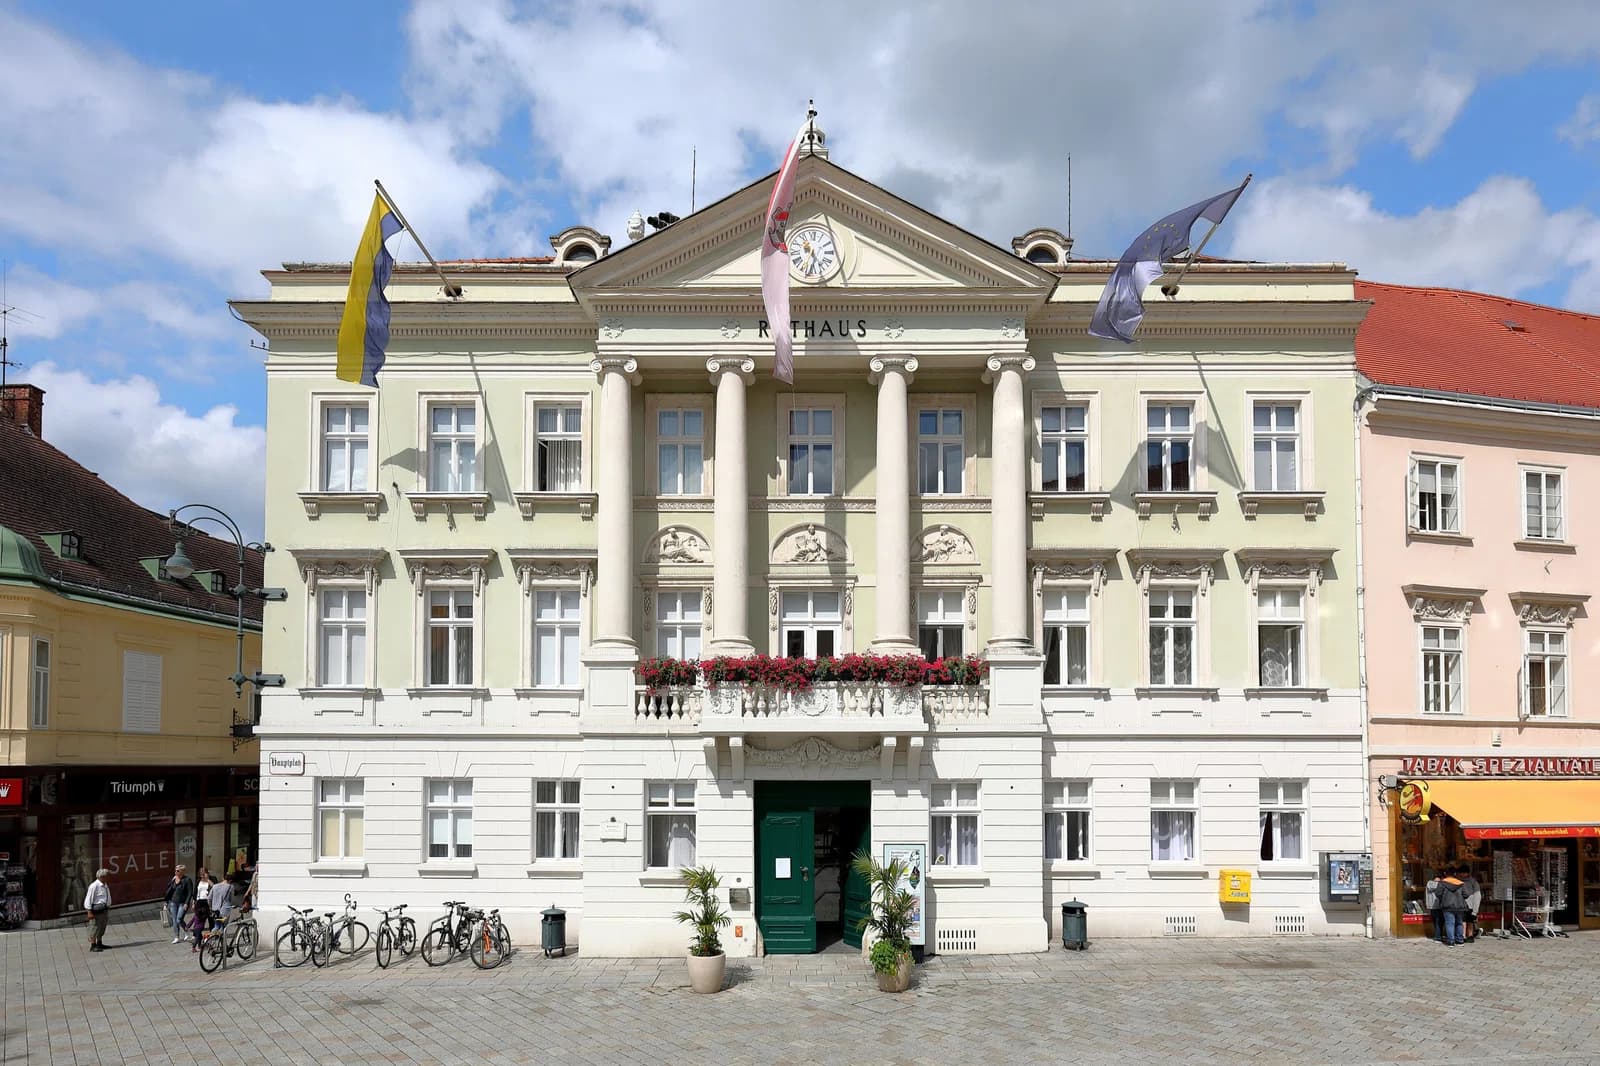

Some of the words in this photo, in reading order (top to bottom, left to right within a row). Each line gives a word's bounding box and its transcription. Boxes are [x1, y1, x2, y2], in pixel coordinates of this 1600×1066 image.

[758, 320, 867, 338] RTHAUS
[1403, 757, 1464, 774] TABAK
[110, 781, 156, 795] Triumph
[109, 851, 169, 875] SALE
